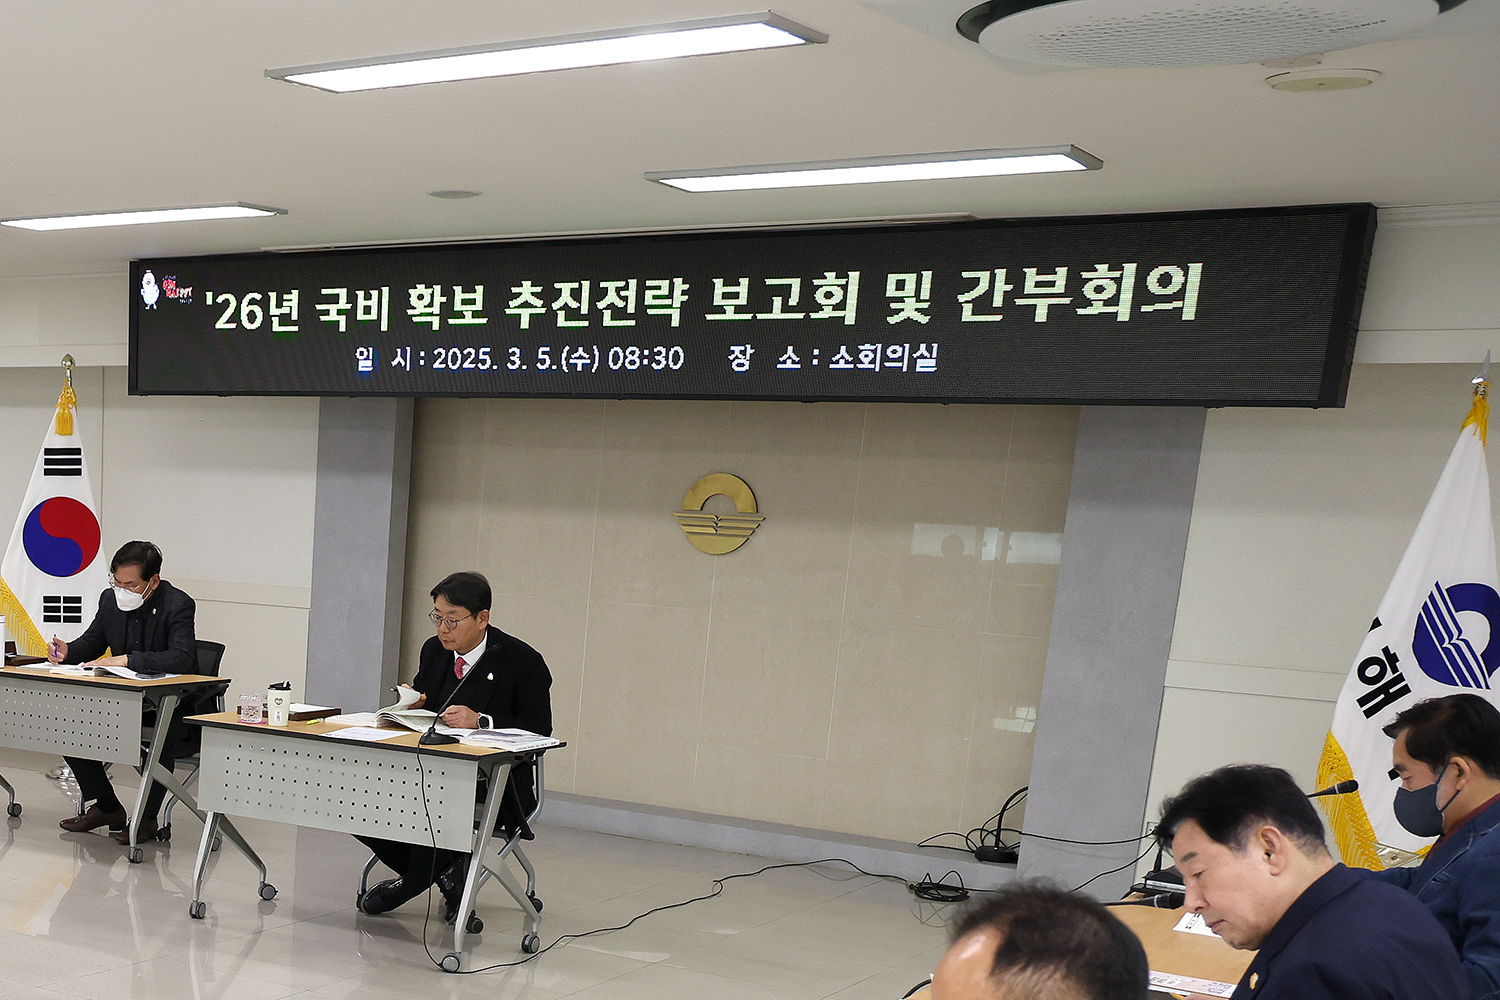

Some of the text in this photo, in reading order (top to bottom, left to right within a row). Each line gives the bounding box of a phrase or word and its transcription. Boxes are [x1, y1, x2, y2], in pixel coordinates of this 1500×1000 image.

[205, 288, 300, 333] '26년
[314, 284, 390, 333] 국비
[405, 282, 490, 332] 확보
[503, 276, 690, 330] 추진전략
[704, 270, 861, 326] 보고회
[885, 269, 933, 326] 및
[956, 262, 1204, 323] 간부회의
[354, 346, 378, 374] 일
[506, 346, 528, 371] 3.
[608, 345, 685, 371] 08:30
[727, 344, 756, 374] 장
[828, 343, 939, 374] 소회의실
